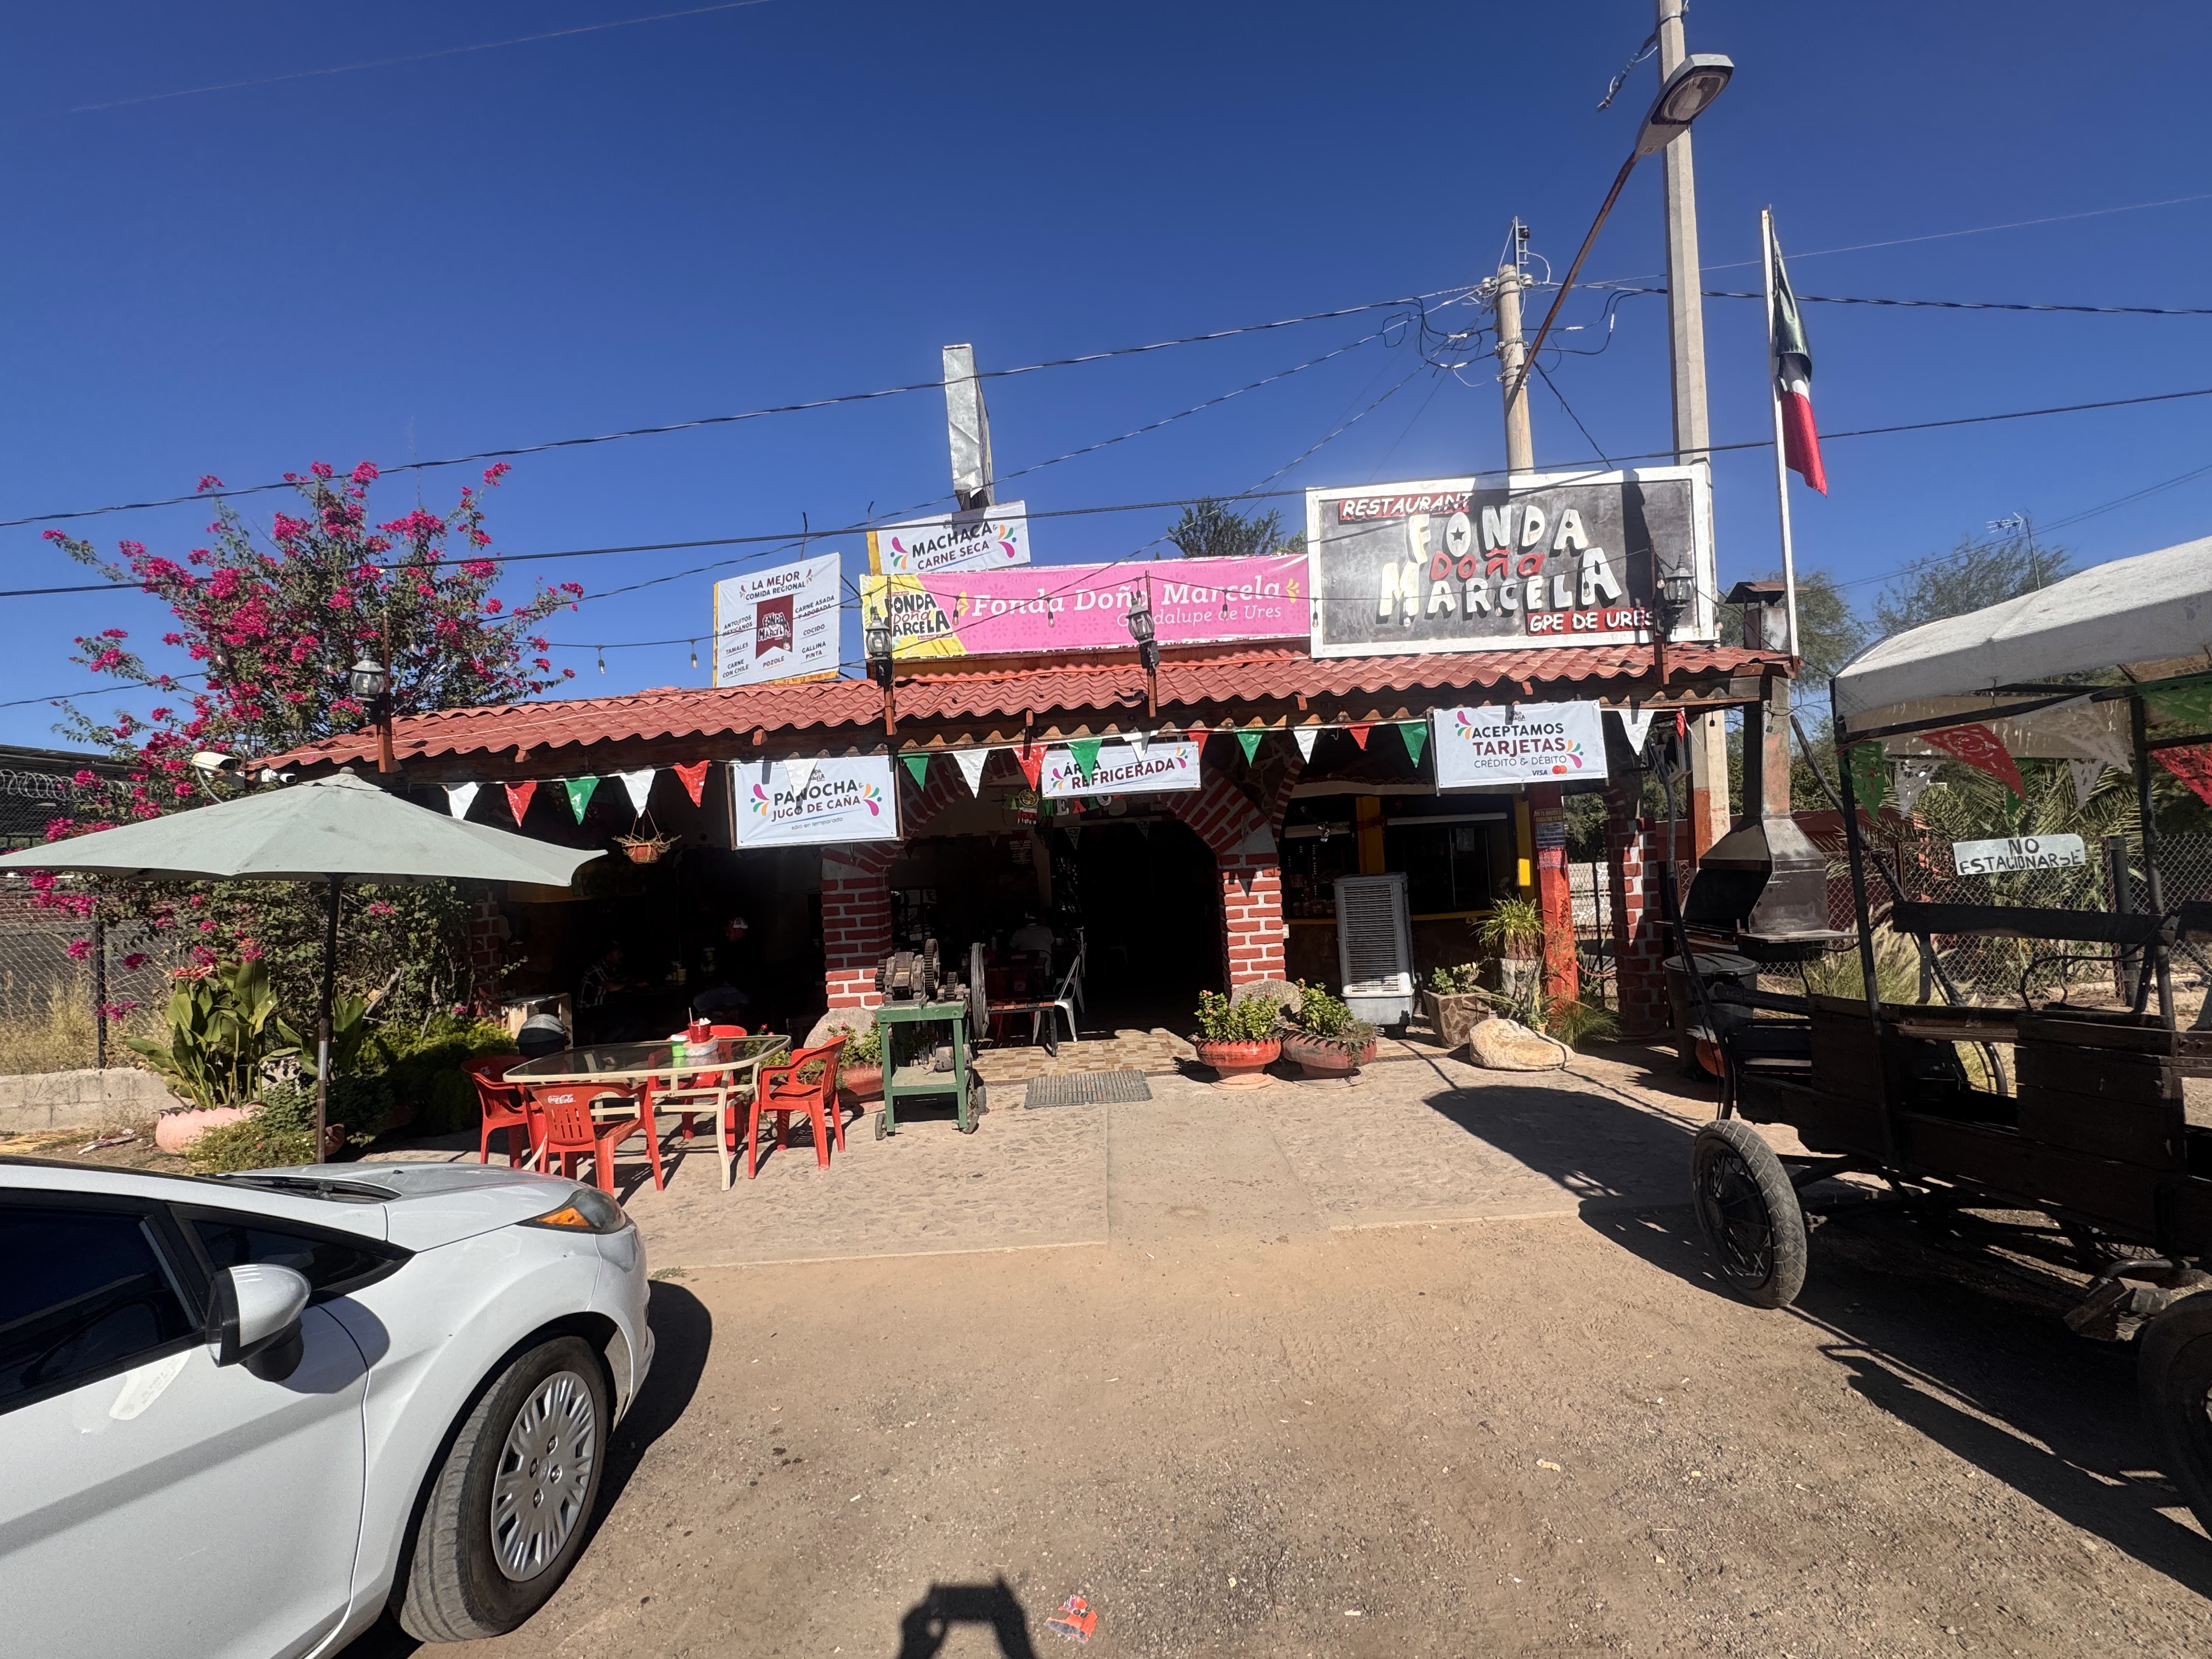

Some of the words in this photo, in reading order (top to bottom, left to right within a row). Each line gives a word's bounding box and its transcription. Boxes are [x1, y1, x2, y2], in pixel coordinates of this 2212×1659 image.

[1342, 493, 1474, 516] RESTAURANT
[912, 521, 992, 558] MACHACA
[1407, 505, 1589, 564] FONDA
[917, 550, 956, 570] CARNE
[960, 540, 990, 557] SECA
[752, 581, 764, 590] LA
[767, 571, 800, 586] MEJOR
[1379, 548, 1622, 617] MARCELA
[746, 589, 770, 601] COMIDA
[772, 582, 806, 594] REGIONAL
[972, 589, 1065, 617] Fonda
[1161, 575, 1282, 606] Marcela
[795, 602, 814, 613] CARNE
[815, 595, 834, 607] ASADA
[724, 615, 752, 630] ANTOJITOS
[884, 610, 950, 636] ARCELA
[1117, 608, 1212, 627] Gdalupe
[1244, 605, 1282, 619] Ures
[1530, 613, 1564, 631] GPE
[1572, 612, 1598, 629] DE
[1606, 610, 1654, 628] URES
[803, 624, 825, 635] COCIDO
[726, 642, 748, 654] TAMALES
[802, 641, 826, 653] GALLINA
[805, 650, 822, 659] PINTA
[727, 659, 744, 669] CARNE
[735, 664, 749, 675] CHILE
[763, 656, 785, 668] POZOLE
[1472, 723, 1564, 738] ACEPTAMOS
[1472, 737, 1566, 757] TARJETAS
[1064, 759, 1102, 777] ÁRA
[1474, 757, 1516, 768] CRÉDITO
[1531, 754, 1566, 765] DÉBITO
[1071, 758, 1175, 789] REFRIGERADA
[774, 779, 857, 806] PANOCHA
[771, 805, 803, 822] JUGO
[807, 802, 823, 813] DE
[827, 795, 861, 809] CAÑA
[2007, 838, 2040, 856] NO
